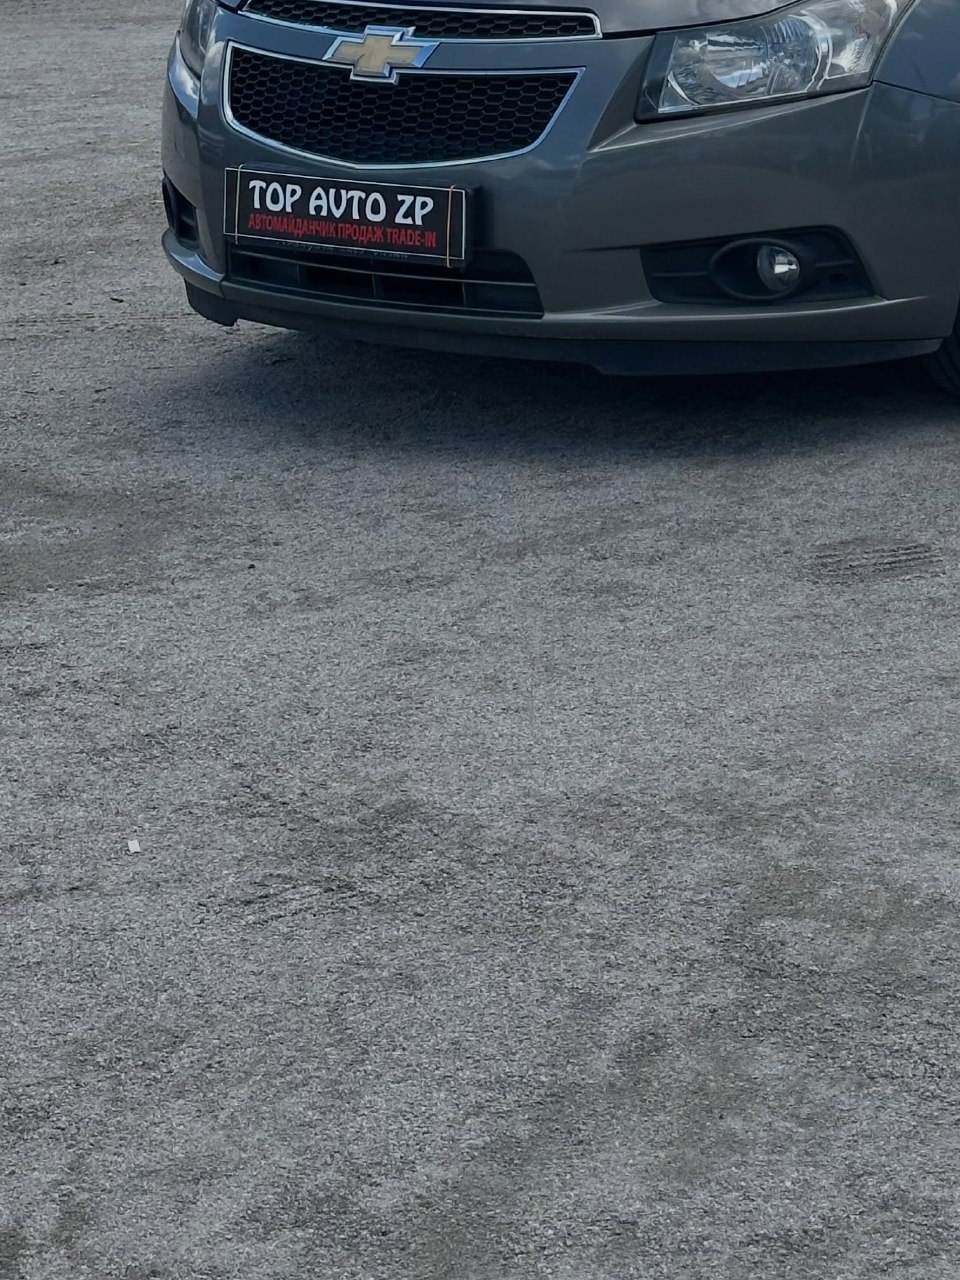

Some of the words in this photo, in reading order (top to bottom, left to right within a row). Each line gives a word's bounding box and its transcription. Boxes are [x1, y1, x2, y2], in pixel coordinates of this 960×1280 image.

[248, 179, 302, 213] TOP
[308, 186, 387, 222] AVTO
[394, 194, 434, 226] ZP
[248, 213, 336, 237] АВТОМАЙДАНЧИК
[337, 223, 384, 243] ПРОДАЖ
[385, 227, 437, 248] TRADE-IN
